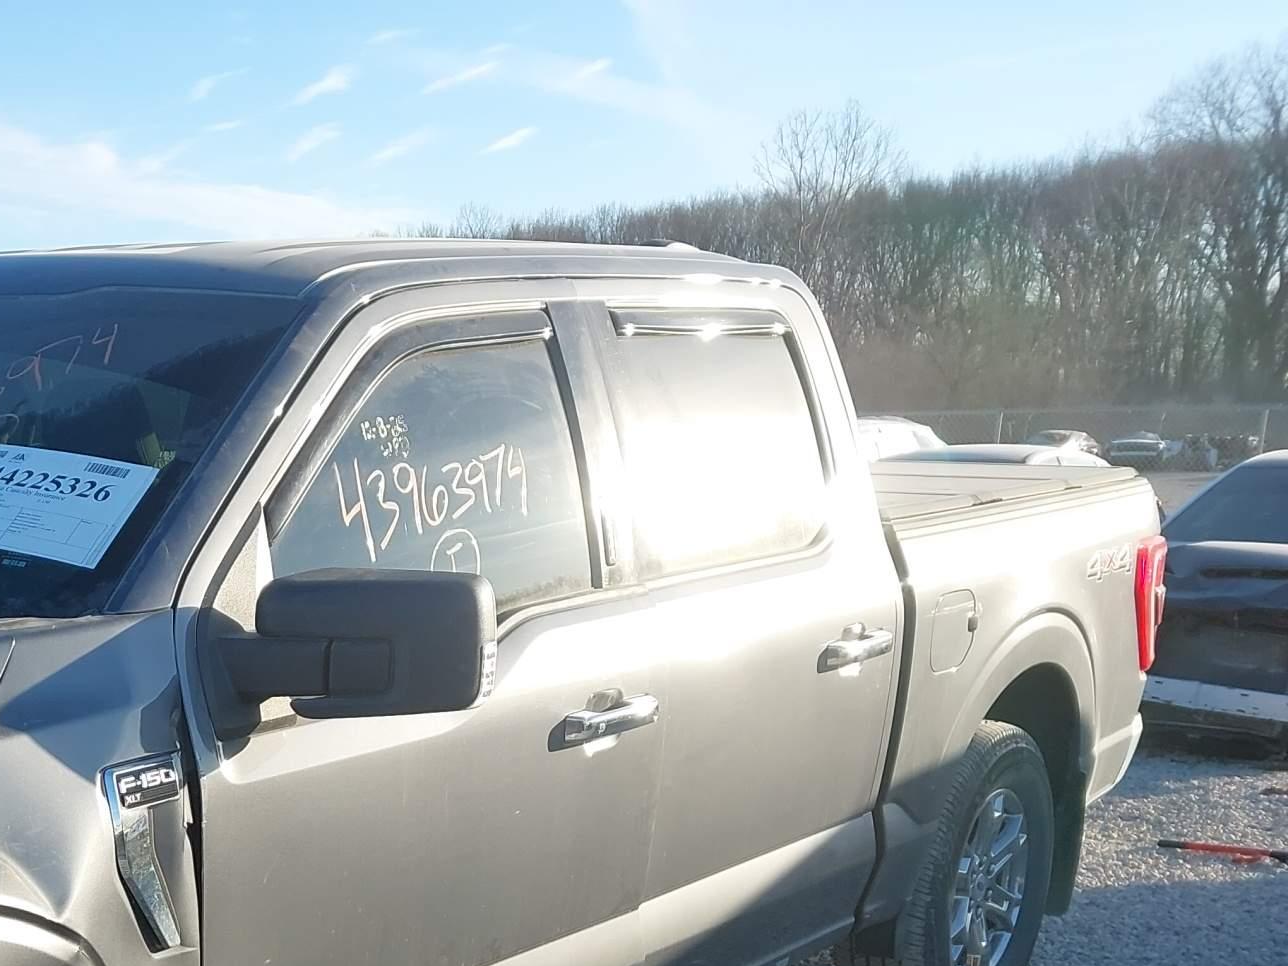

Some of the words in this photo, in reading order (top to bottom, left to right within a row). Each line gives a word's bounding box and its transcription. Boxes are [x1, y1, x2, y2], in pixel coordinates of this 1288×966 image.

[333, 443, 528, 563] 43963974
[120, 768, 176, 794] F-150
[125, 793, 141, 806] XLT
